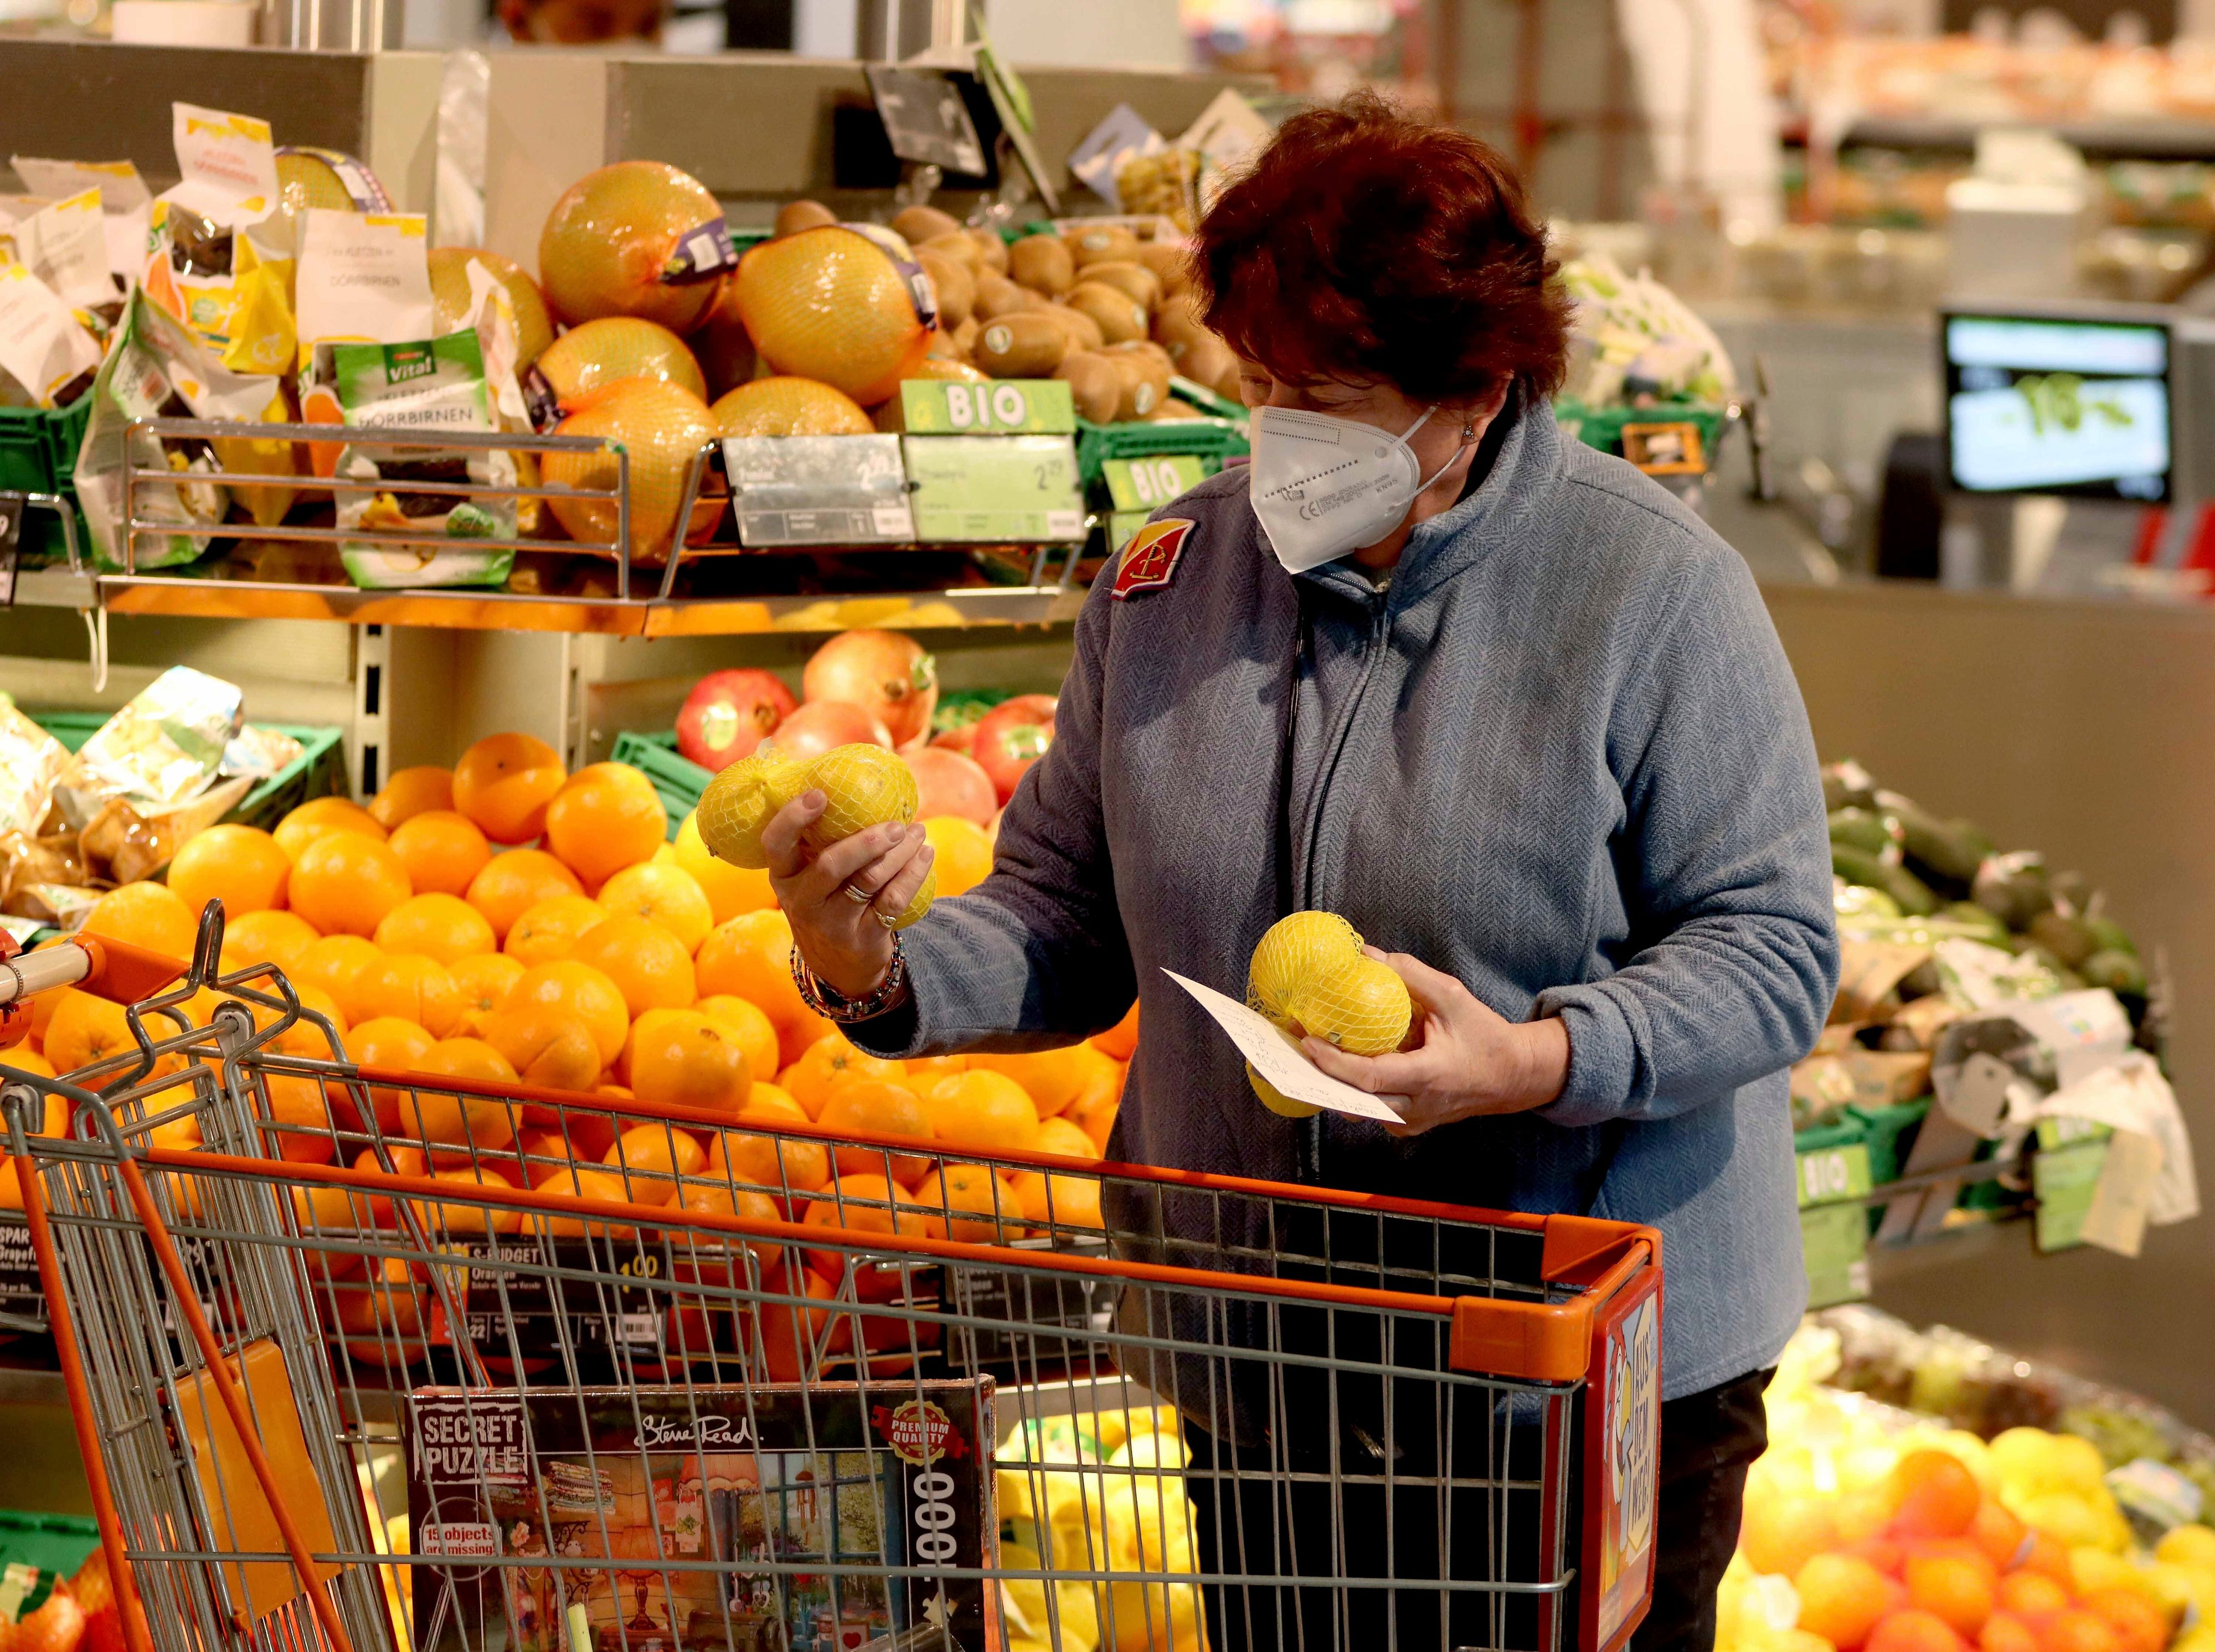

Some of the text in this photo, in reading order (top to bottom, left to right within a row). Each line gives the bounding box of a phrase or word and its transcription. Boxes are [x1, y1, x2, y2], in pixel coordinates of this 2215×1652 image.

[389, 356, 431, 381] Vital
[946, 384, 1027, 429] BIO
[1130, 461, 1181, 503] BIO
[1376, 478, 1398, 494] KN95
[1804, 1154, 1848, 1198] BIO
[0, 1226, 30, 1245] SPAR
[472, 1267, 517, 1281] Oranen
[1635, 1331, 1649, 1402] AUS
[424, 1415, 517, 1444] SECRET
[891, 1419, 949, 1434] PREMIUM
[1634, 1396, 1649, 1468] DEM
[426, 1446, 519, 1475] PUZZLE
[426, 1527, 493, 1543] 15 objects
